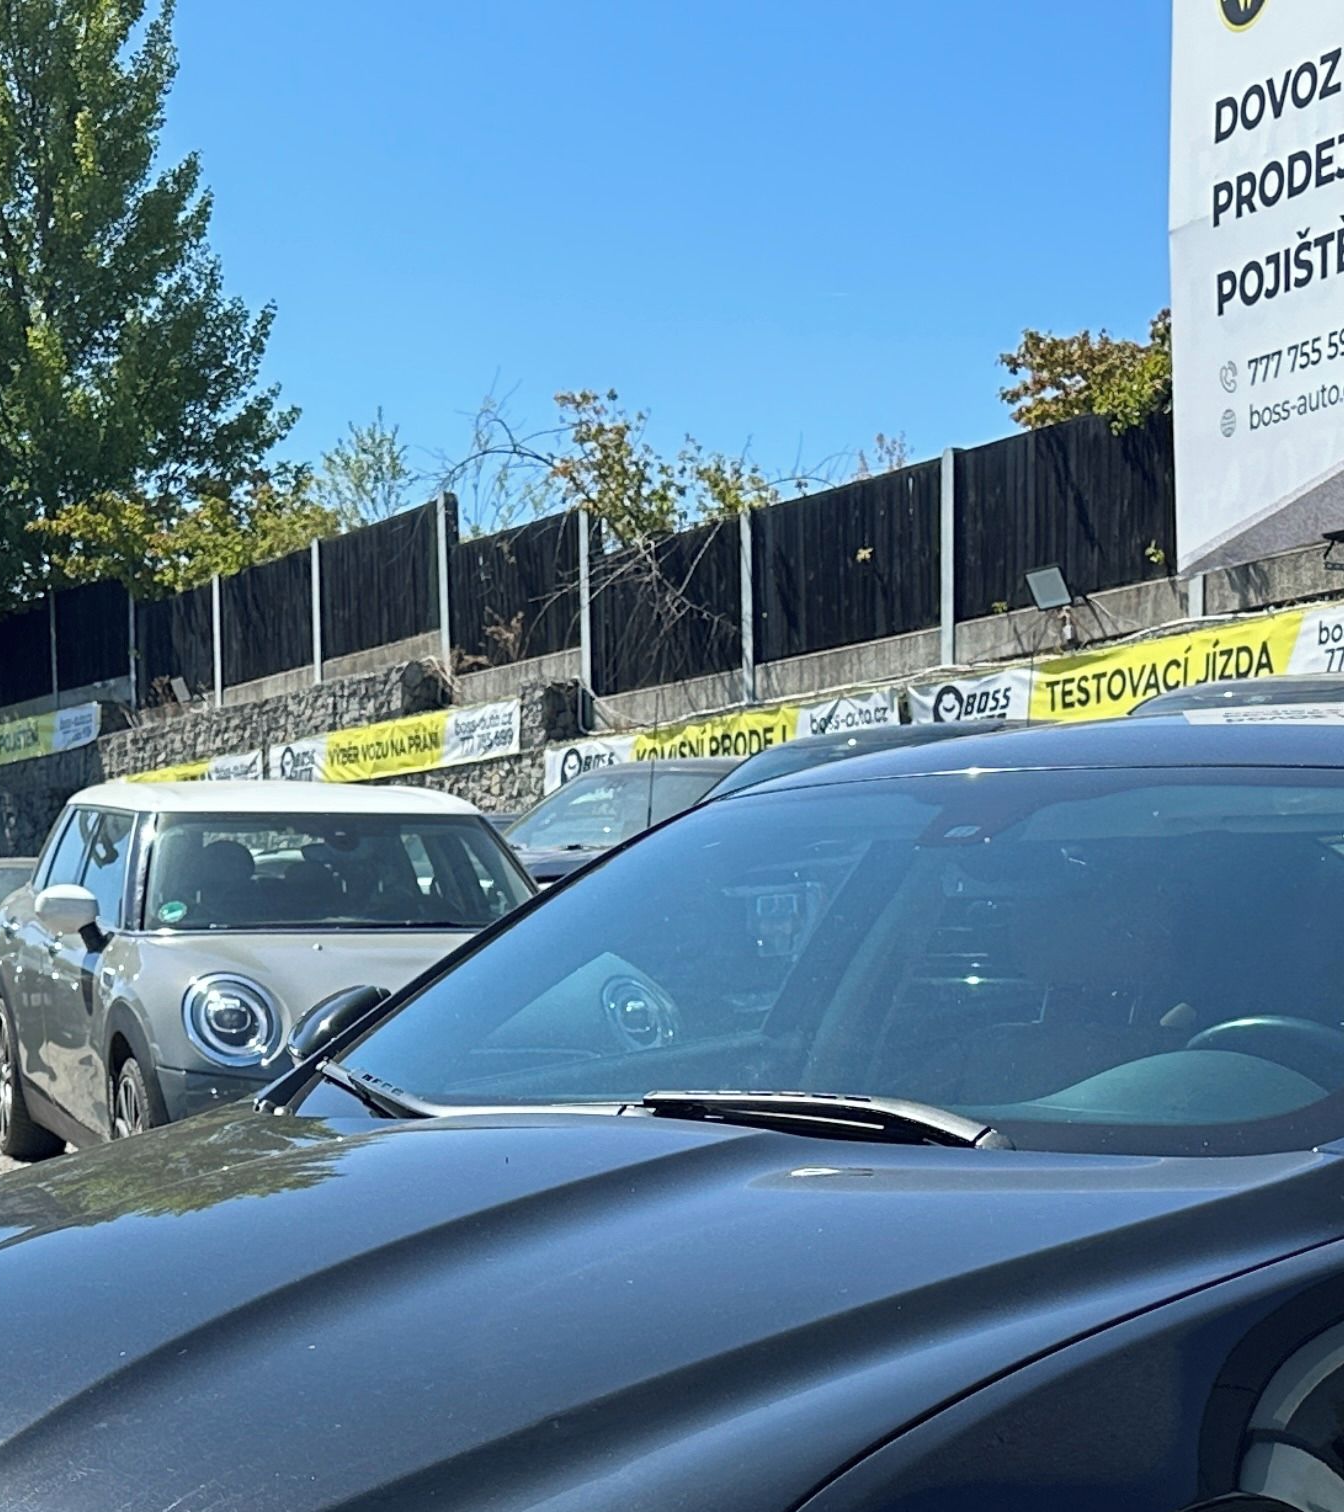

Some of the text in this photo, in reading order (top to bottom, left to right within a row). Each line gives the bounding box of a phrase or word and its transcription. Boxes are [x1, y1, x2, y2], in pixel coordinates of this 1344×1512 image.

[1214, 47, 1343, 145] DOVOZ
[1247, 349, 1283, 387] 777
[1287, 336, 1323, 374] 755
[963, 686, 1012, 714] BOSS
[1045, 640, 1274, 713] TESTOVACÍ JÍZDA
